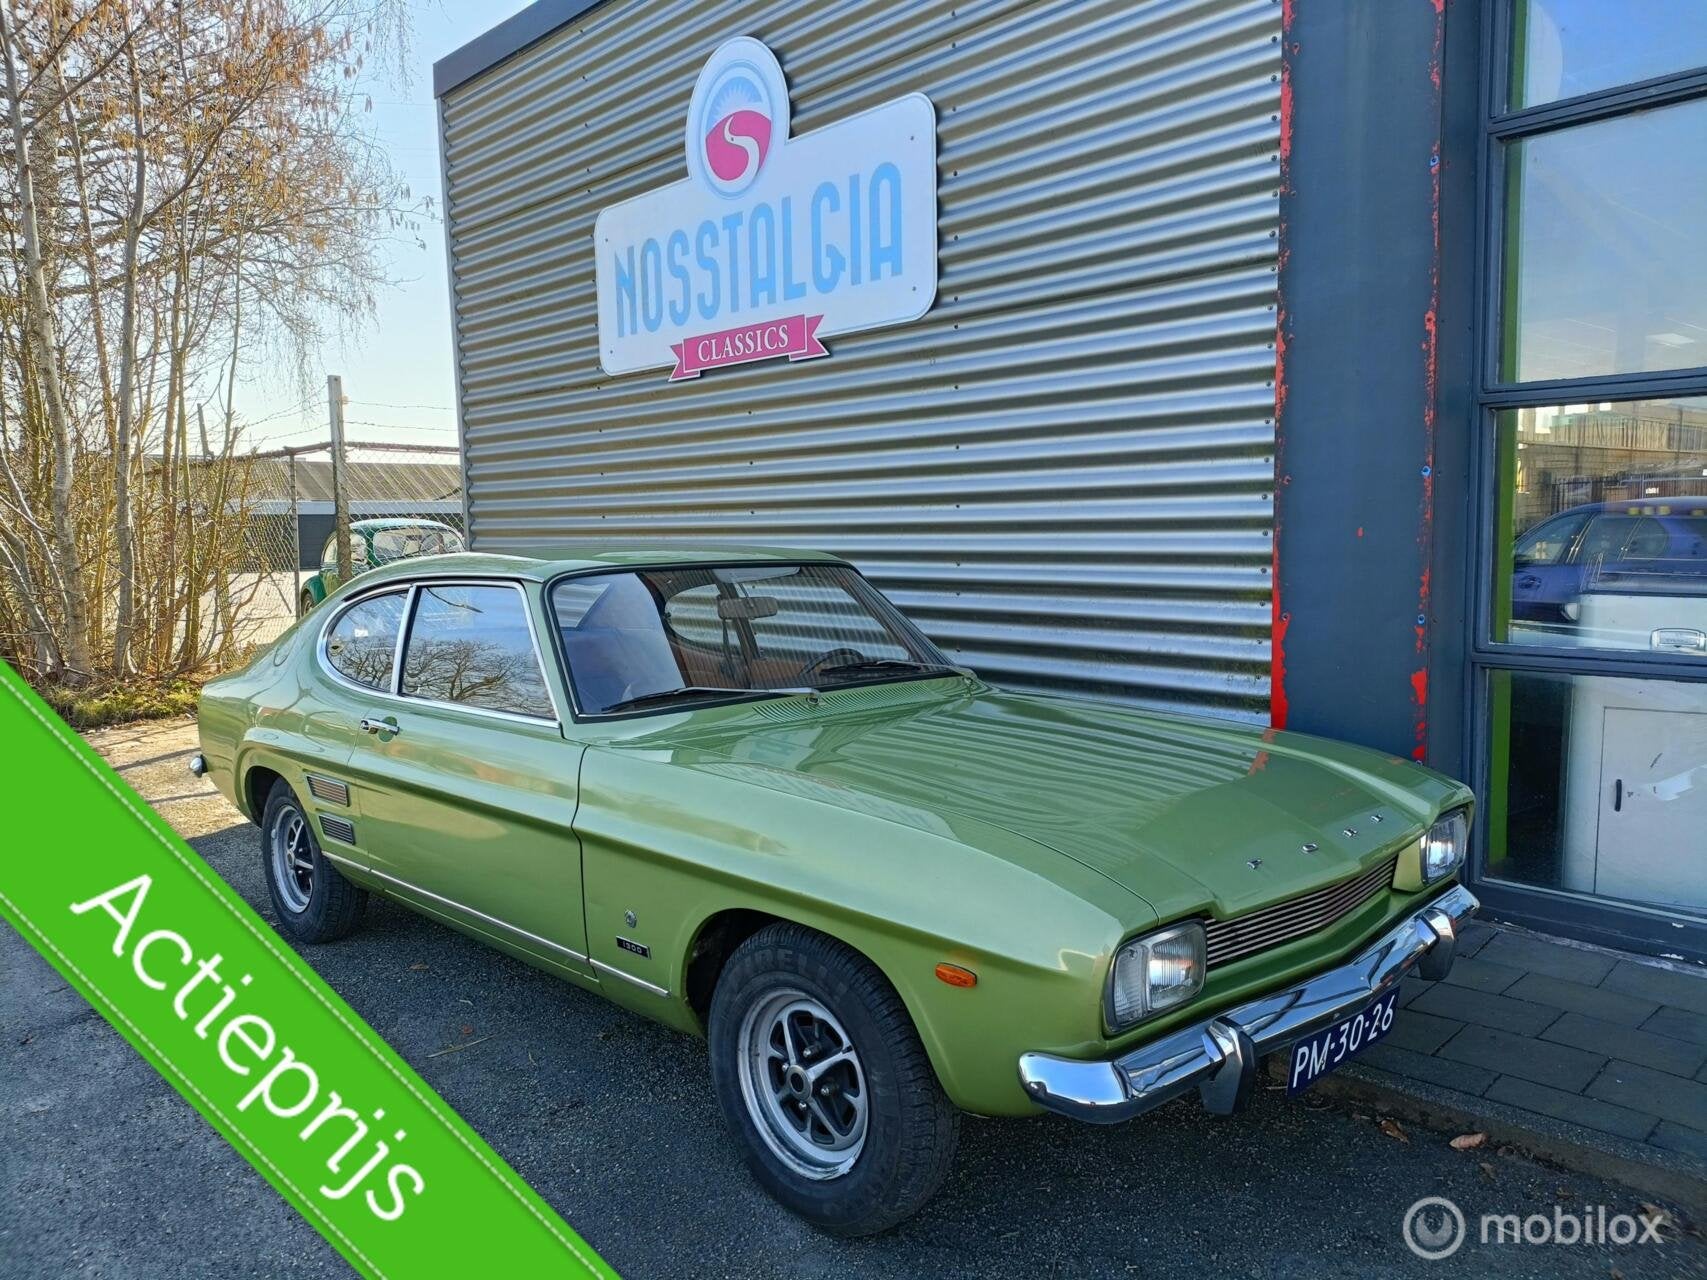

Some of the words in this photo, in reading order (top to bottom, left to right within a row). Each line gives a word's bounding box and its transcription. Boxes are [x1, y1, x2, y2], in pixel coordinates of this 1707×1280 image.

[614, 161, 903, 338] NOSSTALGIA
[698, 324, 789, 362] CLASSICS
[1292, 994, 1396, 1089] PM-30-26
